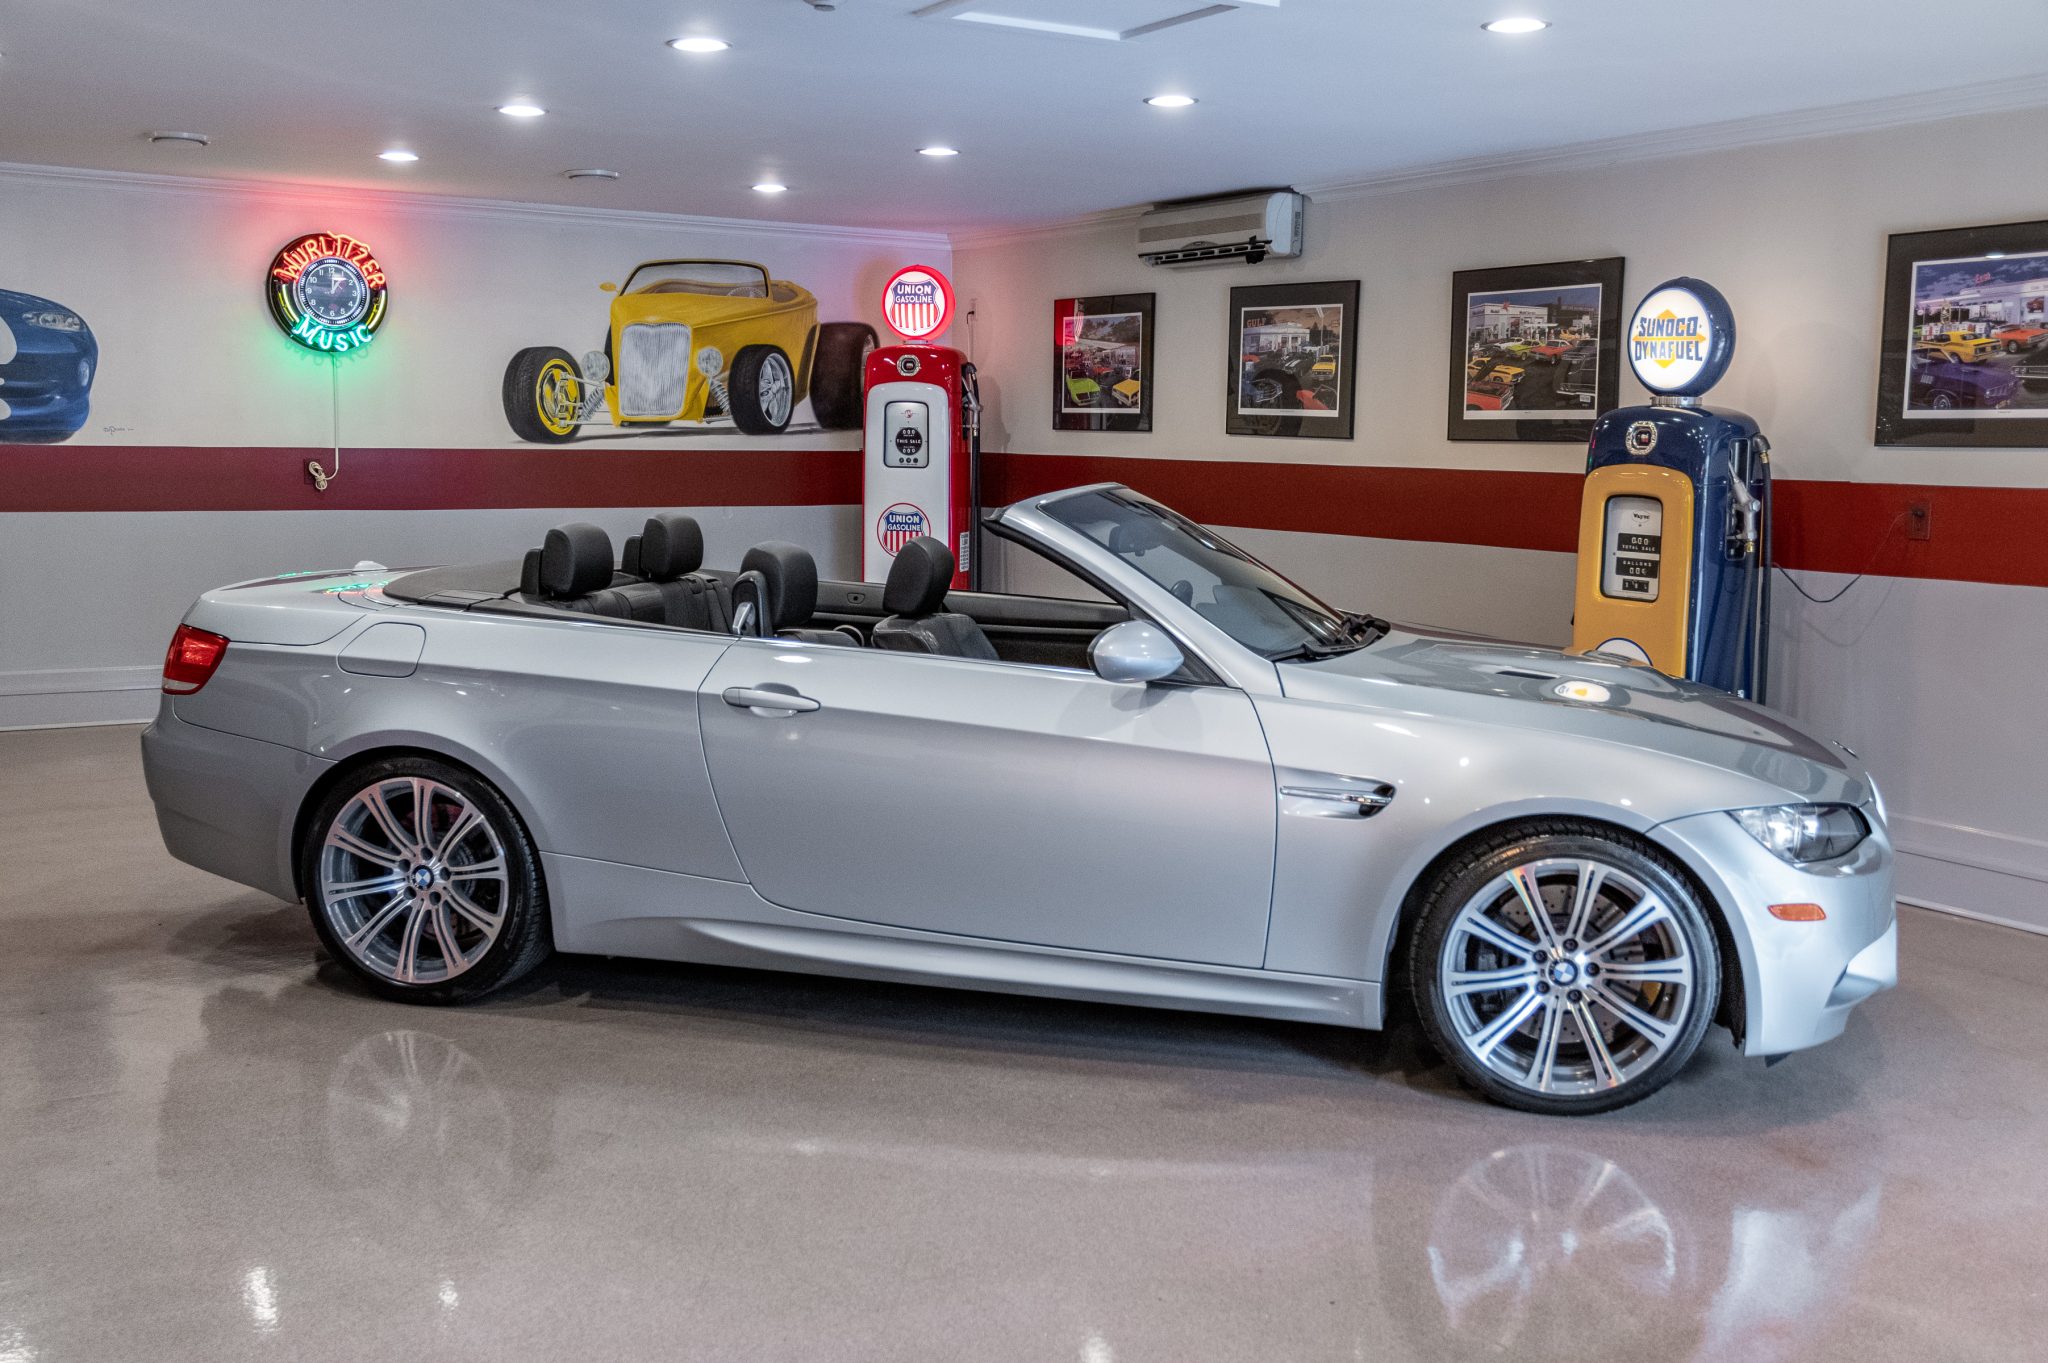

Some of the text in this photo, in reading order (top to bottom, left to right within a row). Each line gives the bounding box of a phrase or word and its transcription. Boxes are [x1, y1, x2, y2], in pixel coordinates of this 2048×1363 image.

[274, 231, 386, 288] WURLITZER
[897, 284, 932, 294] UNION
[895, 295, 933, 304] GASOLINE
[293, 314, 373, 351] MUSIC
[1638, 316, 1699, 337] SUNOCO
[1634, 340, 1703, 361] DYNAFUEL
[889, 514, 920, 524] UNION
[887, 524, 921, 532] GASOLINE
